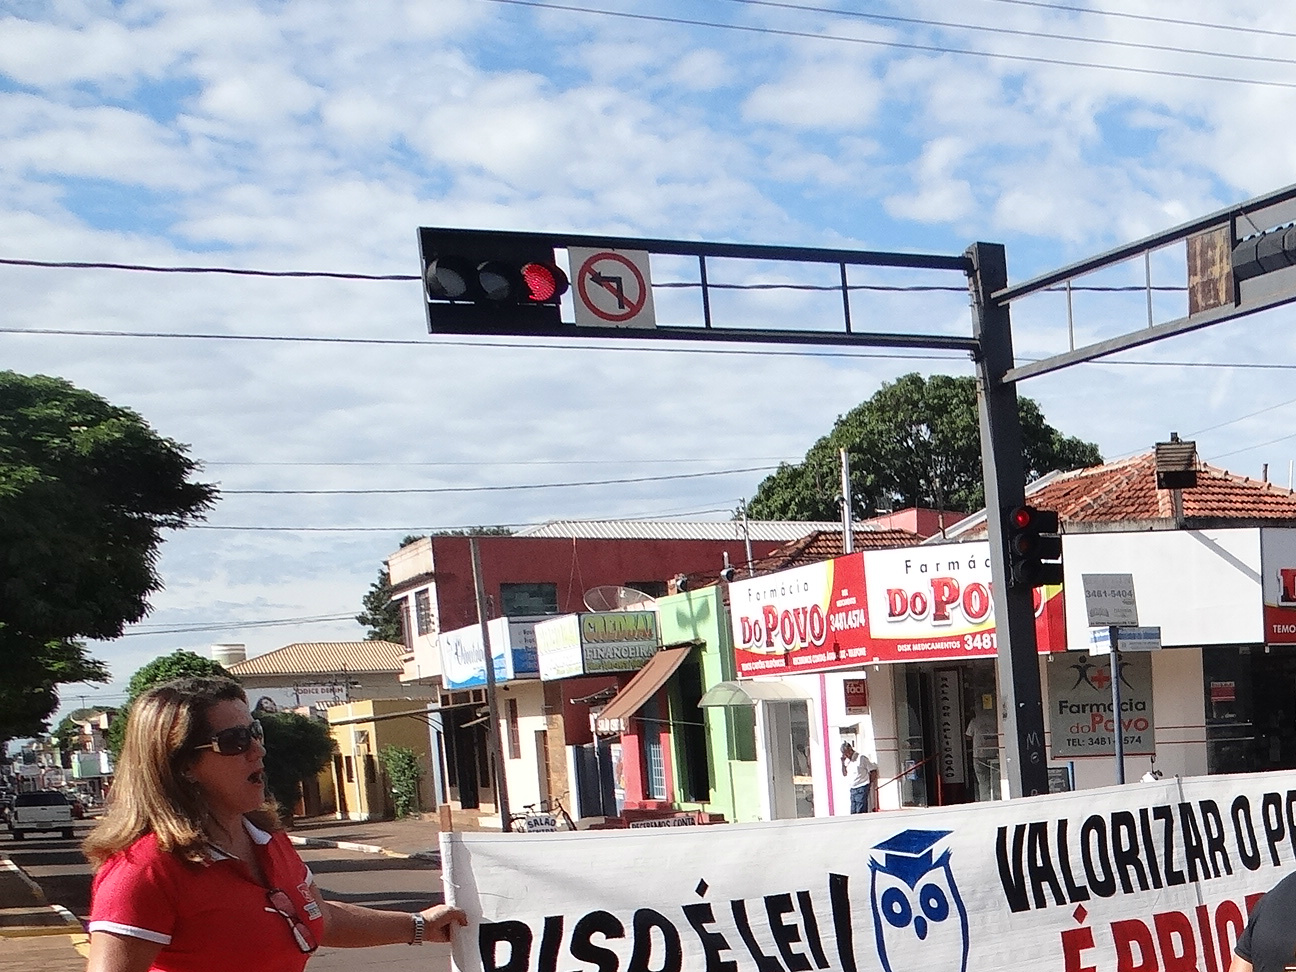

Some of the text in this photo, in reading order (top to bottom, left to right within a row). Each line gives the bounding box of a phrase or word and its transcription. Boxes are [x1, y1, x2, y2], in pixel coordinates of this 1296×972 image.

[904, 555, 991, 574] Farmác
[897, 643, 912, 653] DISK
[912, 640, 961, 652] MEDICAMENTOS
[1066, 735, 1142, 747] TEL: 3481-574
[996, 797, 1233, 914] VALORIZAR
[1230, 794, 1261, 871] O
